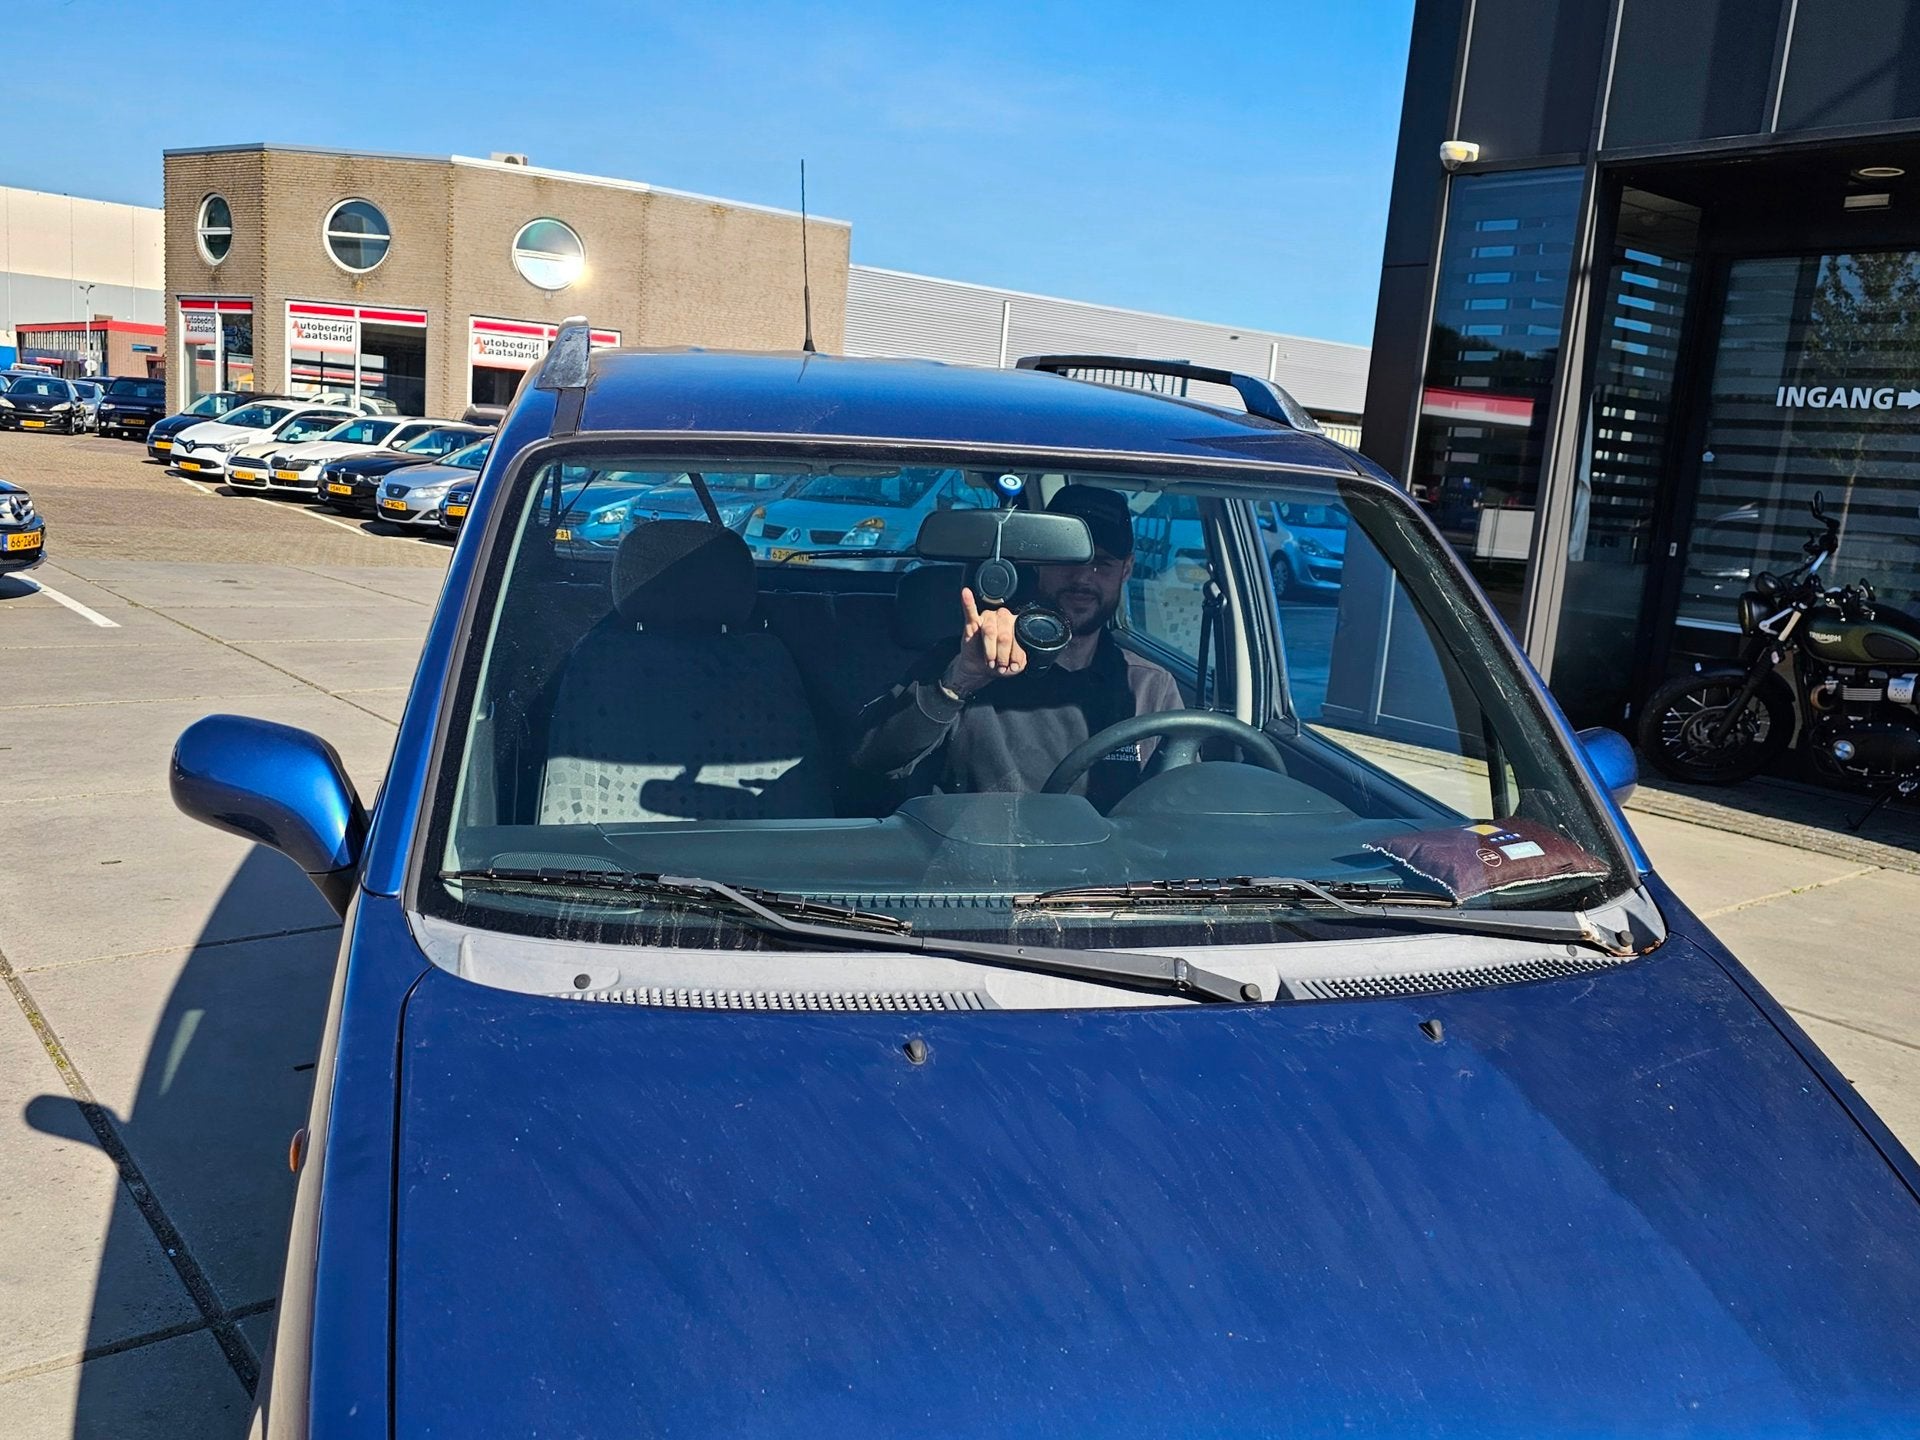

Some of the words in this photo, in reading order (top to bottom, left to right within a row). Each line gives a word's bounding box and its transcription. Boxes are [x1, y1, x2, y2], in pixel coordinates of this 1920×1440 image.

[292, 320, 353, 335] Autobedrijf
[296, 329, 352, 342] Kaatsland
[474, 336, 540, 352] Autobedrijf
[479, 345, 539, 360] Kaatsland
[1776, 386, 1895, 410] INGANG
[1809, 631, 1842, 643] TRIUMPH
